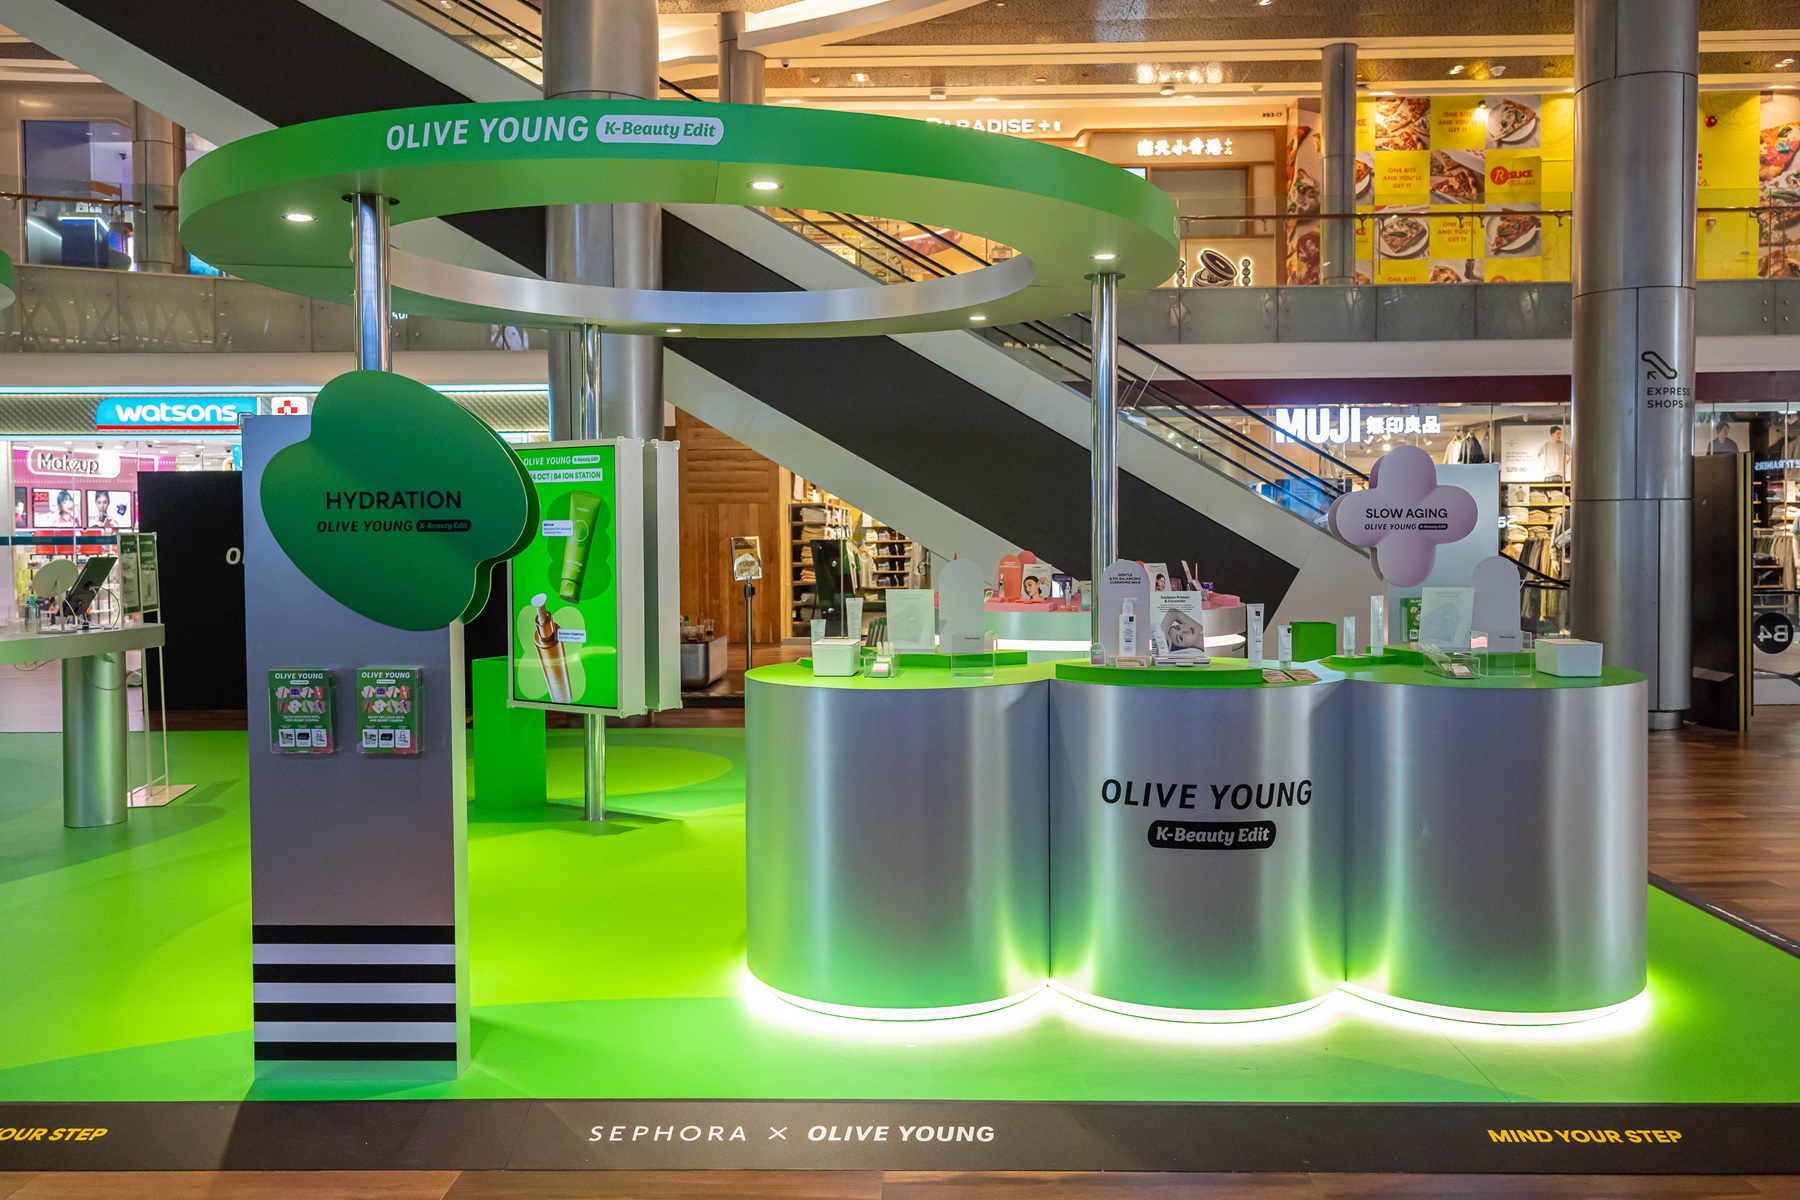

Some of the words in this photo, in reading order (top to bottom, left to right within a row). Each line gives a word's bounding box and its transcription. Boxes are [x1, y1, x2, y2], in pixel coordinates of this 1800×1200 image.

[386, 119, 470, 151] OLIVE
[479, 115, 589, 144] YOUNG
[604, 121, 680, 139] K-Beauty
[683, 122, 717, 138] Edit
[1646, 387, 1691, 396] EXPRESS
[115, 402, 238, 422] watsons
[1646, 399, 1684, 409] SHOPS
[1275, 407, 1361, 444] MUJI
[1365, 414, 1441, 435] 無印良品
[37, 452, 99, 475] Makeup
[524, 457, 544, 466] OLIVE
[546, 456, 571, 465] YOUNG
[575, 471, 601, 479] STATION
[325, 490, 462, 510] HYDRATION
[1365, 508, 1403, 519] SLOW
[1405, 508, 1448, 519] AGING
[316, 520, 359, 533] OLIVE
[363, 519, 414, 532] YOUNG
[419, 521, 452, 531] K-Beauty
[453, 521, 468, 530] Edit
[1101, 778, 1198, 809] OLIVE
[1210, 779, 1313, 810] YOUNG
[1155, 826, 1235, 846] K-Beauty
[1237, 827, 1270, 843] Edit
[48, 1127, 109, 1141] STEP
[588, 1125, 747, 1142] SEPHORA
[807, 1125, 890, 1142] OLIVE
[898, 1125, 995, 1142] YOUNG
[1487, 1129, 1553, 1143] MIND
[1553, 1129, 1624, 1143] YOUR
[1627, 1129, 1682, 1143] STEP
